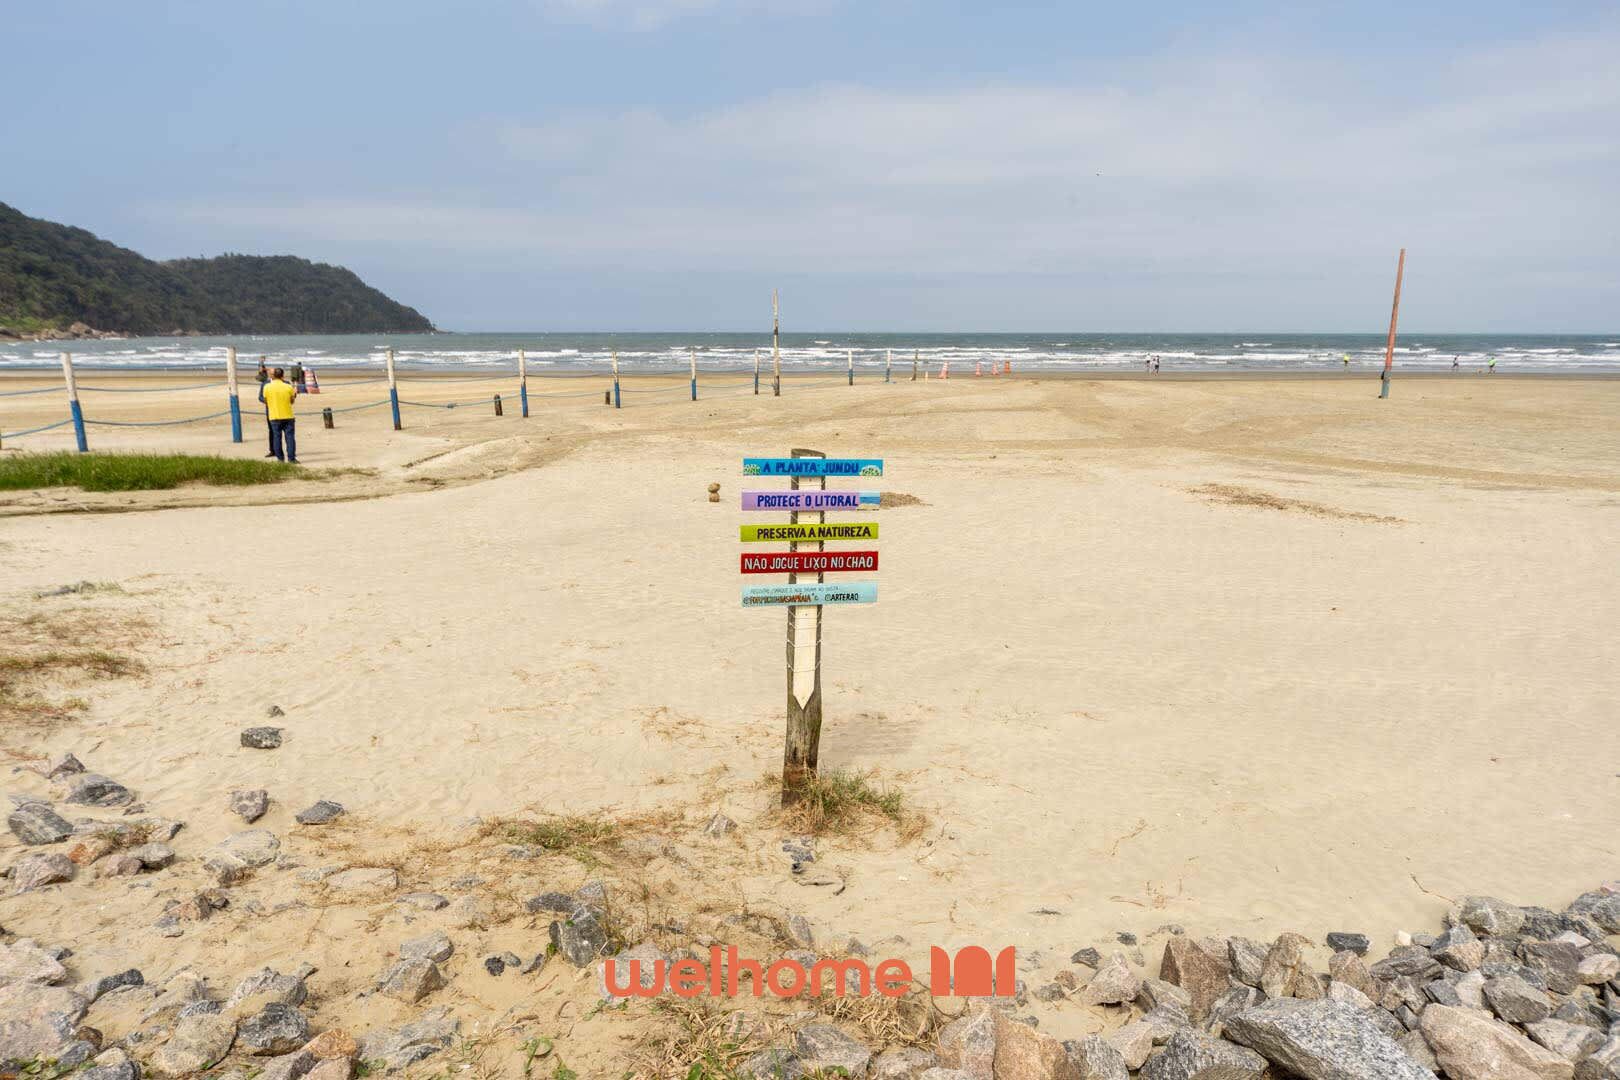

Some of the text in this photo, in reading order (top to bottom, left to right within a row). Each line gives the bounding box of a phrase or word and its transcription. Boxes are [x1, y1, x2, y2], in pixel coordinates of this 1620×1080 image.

[763, 462, 771, 473] A
[775, 462, 818, 473] PLANTA
[757, 495, 859, 507] PROTECE O LITORAL
[757, 526, 871, 540] PRESERVA A NATUREZA
[769, 557, 799, 570] JOGUE
[803, 556, 827, 570] LIXO
[830, 556, 844, 569] NO
